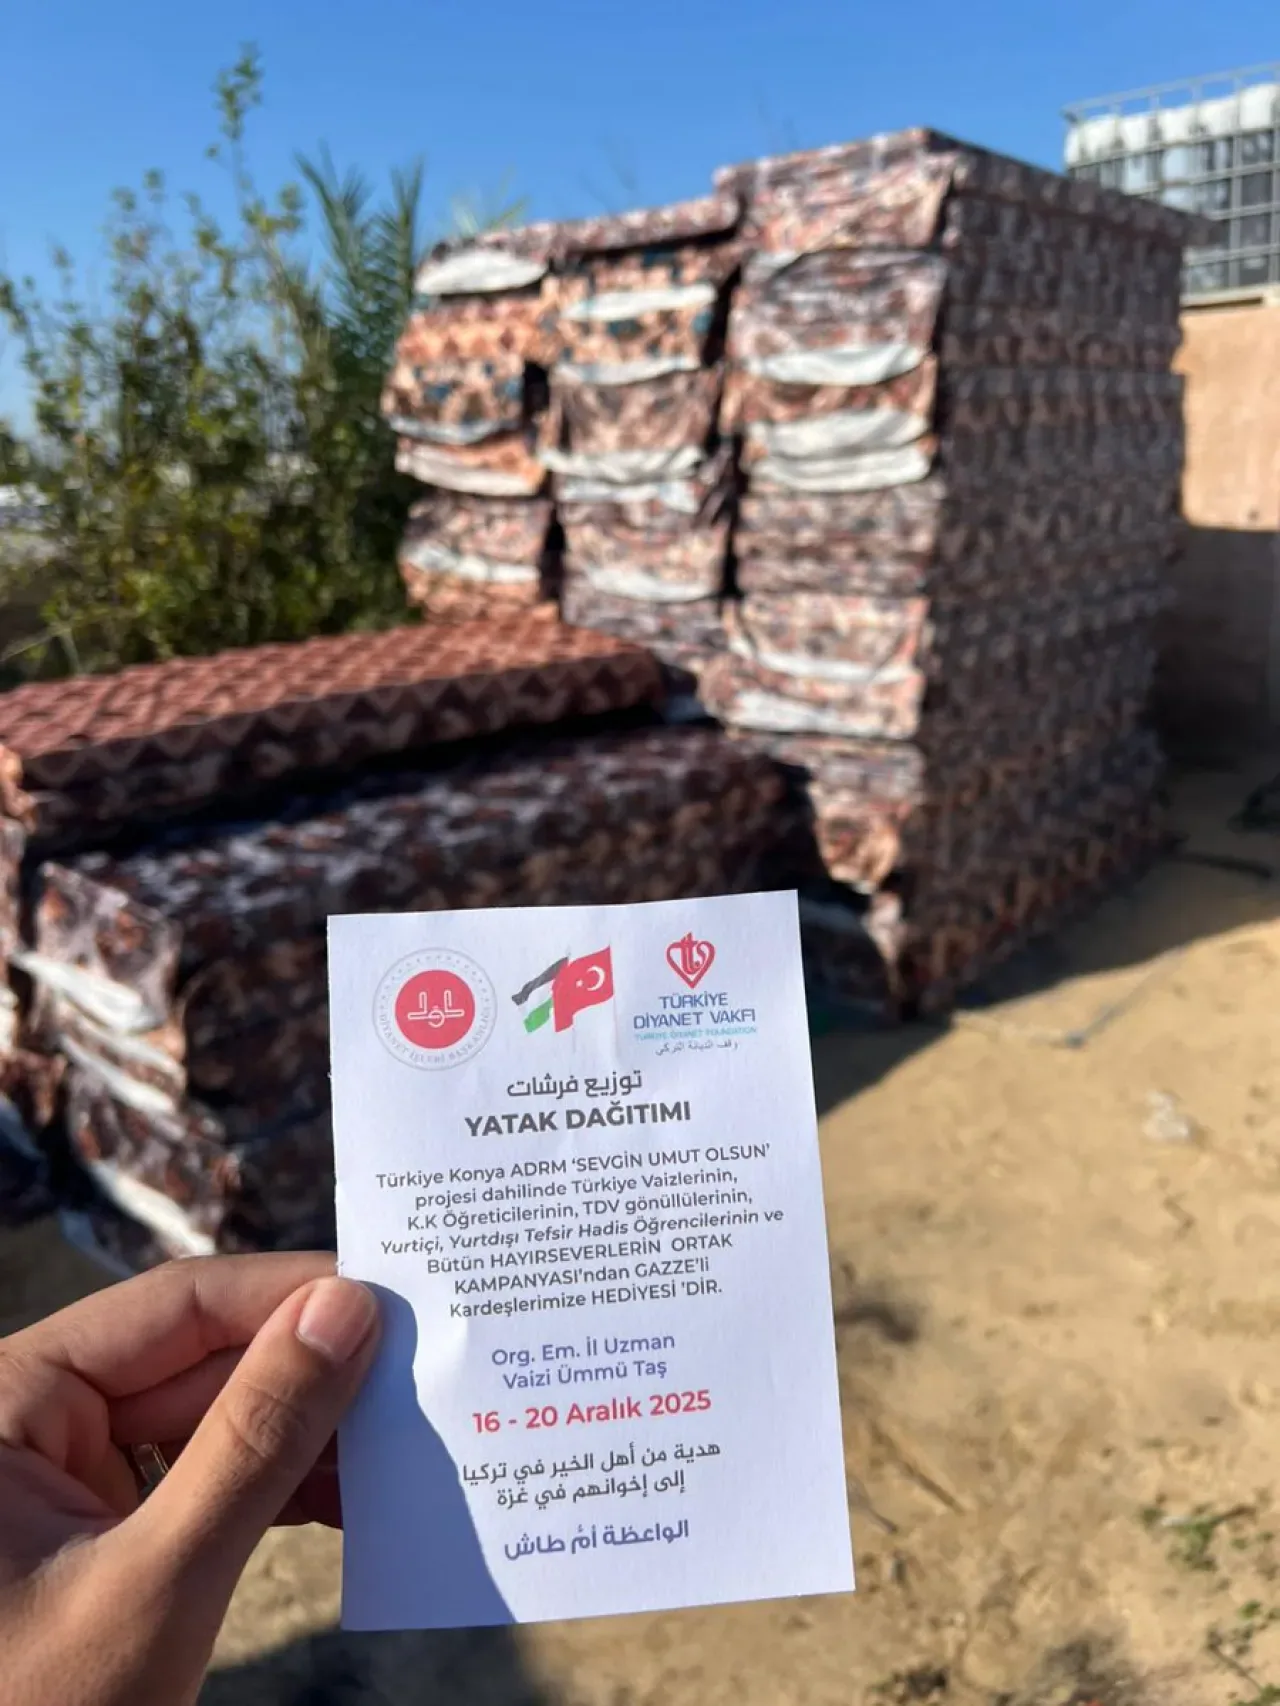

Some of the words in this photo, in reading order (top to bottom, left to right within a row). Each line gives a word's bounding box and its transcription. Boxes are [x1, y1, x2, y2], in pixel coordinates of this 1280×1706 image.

[658, 992, 728, 1010] TÜRKİYE
[633, 1012, 704, 1029] DİYANET
[709, 1009, 756, 1024] VAKFI
[507, 1074, 579, 1100] فرشات
[584, 1070, 643, 1096] توزيع
[465, 1111, 557, 1136] YATAK
[566, 1101, 691, 1130] DAĞITIMI
[376, 1170, 445, 1190] Türkiye
[449, 1164, 505, 1183] Konya
[511, 1160, 566, 1175] ADRM
[648, 1149, 700, 1167] UMUT
[415, 1189, 478, 1210] projesi
[482, 1183, 567, 1203] dahilinde
[572, 1176, 637, 1195] Türkiye
[641, 1168, 738, 1189] Vaizlerinin,
[407, 1214, 437, 1231] K.K
[443, 1202, 579, 1228] Öğreticilerinin,
[583, 1197, 620, 1215] TDV
[625, 1188, 753, 1213] gönüllülerinin,
[381, 1235, 444, 1255] Yurtiçi,
[449, 1229, 520, 1248] Yurtdışı
[524, 1225, 574, 1242] Tefsir
[579, 1219, 628, 1237] Hadis
[634, 1209, 759, 1236] Öğrencilerinin
[764, 1209, 784, 1223] ve
[427, 1257, 484, 1274] Bütün
[490, 1237, 661, 1269] HAYIRSEVERLERİN
[671, 1233, 733, 1252] ORTAK
[449, 1292, 587, 1318] Kardeşlerimize
[591, 1283, 676, 1306] HEDİYESİ
[492, 1347, 535, 1368] Org.
[542, 1343, 580, 1361] Em.
[586, 1337, 598, 1357] İl
[604, 1334, 675, 1355] Uzman
[503, 1368, 551, 1390] Vaizi
[558, 1362, 628, 1385] Ümmü
[633, 1360, 667, 1379] Taş
[473, 1411, 500, 1433] 16
[526, 1406, 558, 1428] 20
[566, 1397, 643, 1425] Aralık
[649, 1389, 711, 1415] 2025
[551, 1452, 594, 1477] الخير
[601, 1442, 636, 1471] أهل
[641, 1448, 667, 1467] من
[674, 1443, 721, 1464] هدية
[463, 1461, 508, 1485] تركيا
[513, 1460, 546, 1485] في
[654, 1470, 685, 1494] إلى
[497, 1486, 528, 1509] غزة
[534, 1485, 566, 1510] في
[572, 1473, 648, 1503] إخوانهم
[504, 1533, 565, 1560] طاش
[602, 1519, 690, 1547] الواعظة
